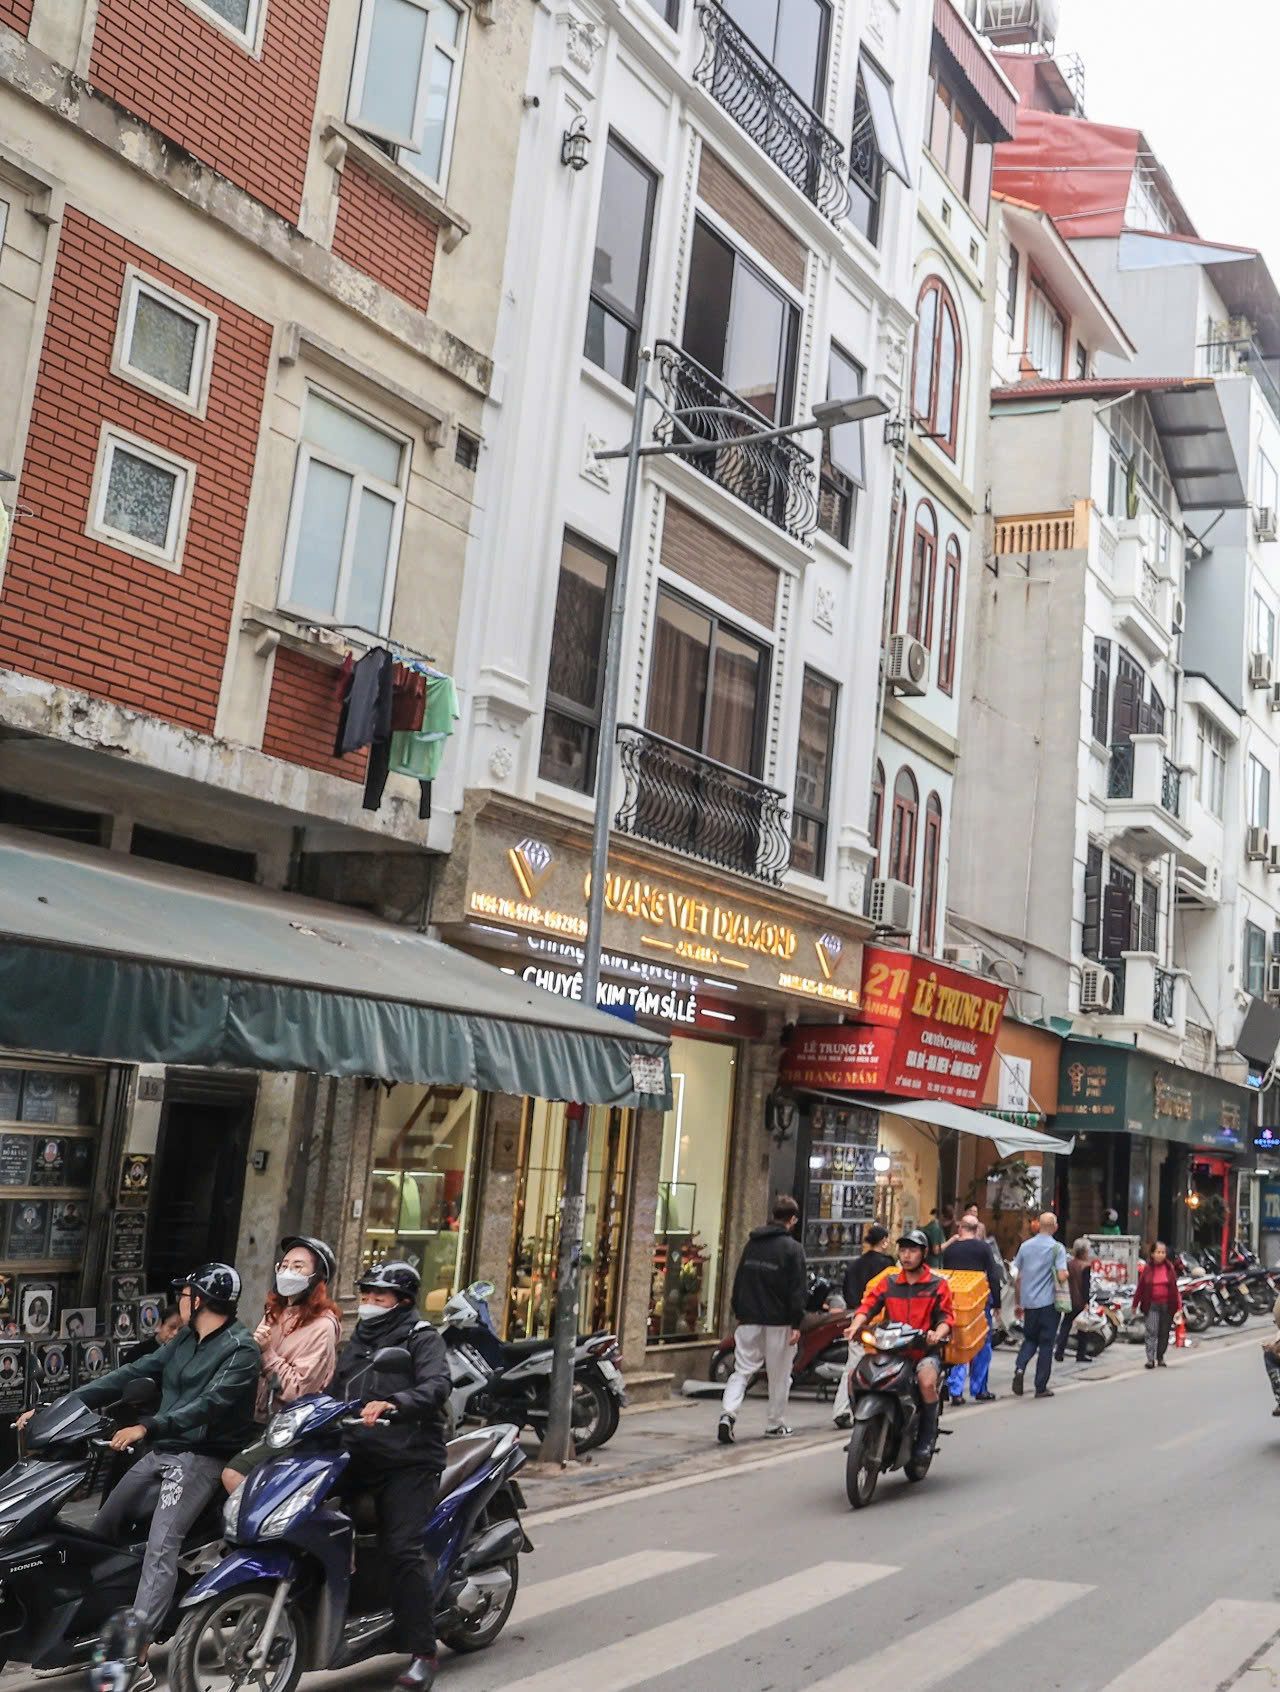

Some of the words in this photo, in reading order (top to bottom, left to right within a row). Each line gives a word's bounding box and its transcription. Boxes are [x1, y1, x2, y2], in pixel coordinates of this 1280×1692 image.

[713, 906, 798, 960] DIAMOND
[523, 966, 584, 1001] CHUYÊ
[596, 982, 625, 1006] KIM
[936, 984, 982, 1029] TRUNG
[820, 1043, 857, 1055] TRUNG
[10, 1560, 44, 1573] HONDA
